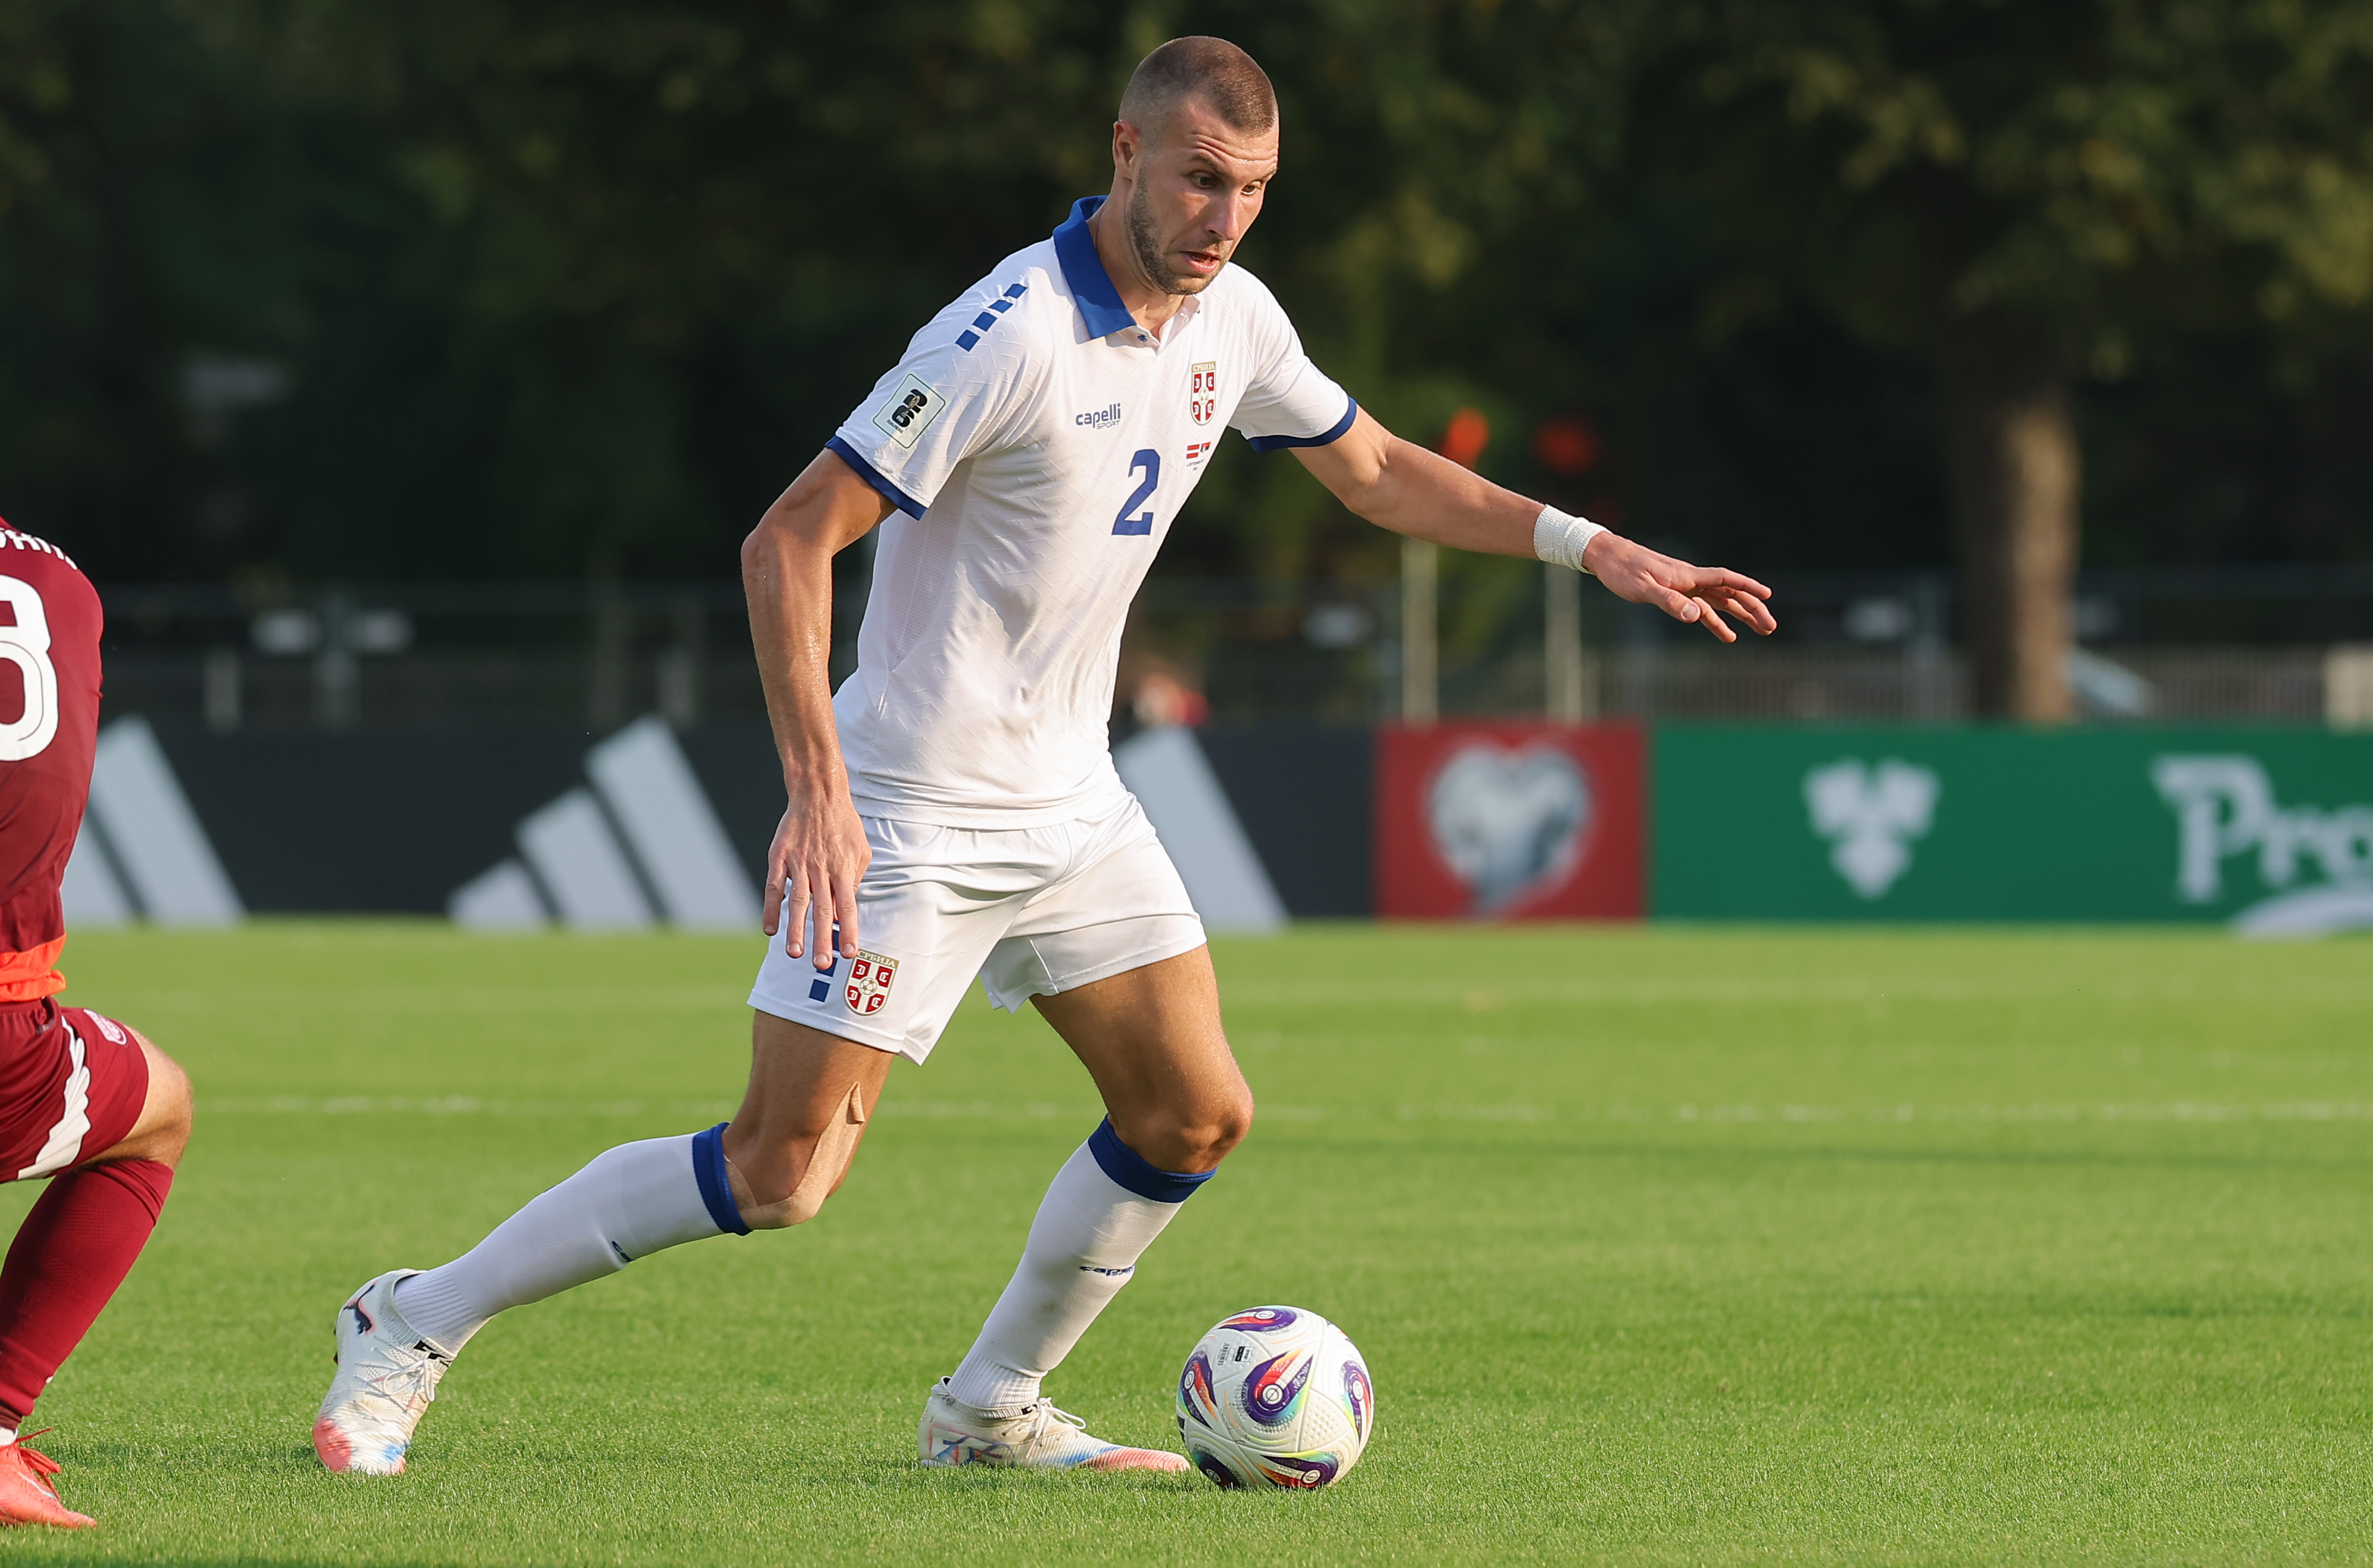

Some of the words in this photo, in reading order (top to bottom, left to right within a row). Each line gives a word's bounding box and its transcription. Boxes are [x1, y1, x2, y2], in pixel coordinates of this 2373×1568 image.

[1075, 403, 1121, 428] capelli
[1097, 420, 1121, 429] SPORT
[1111, 448, 1161, 535] 2
[857, 950, 895, 968] СРБИЈА
